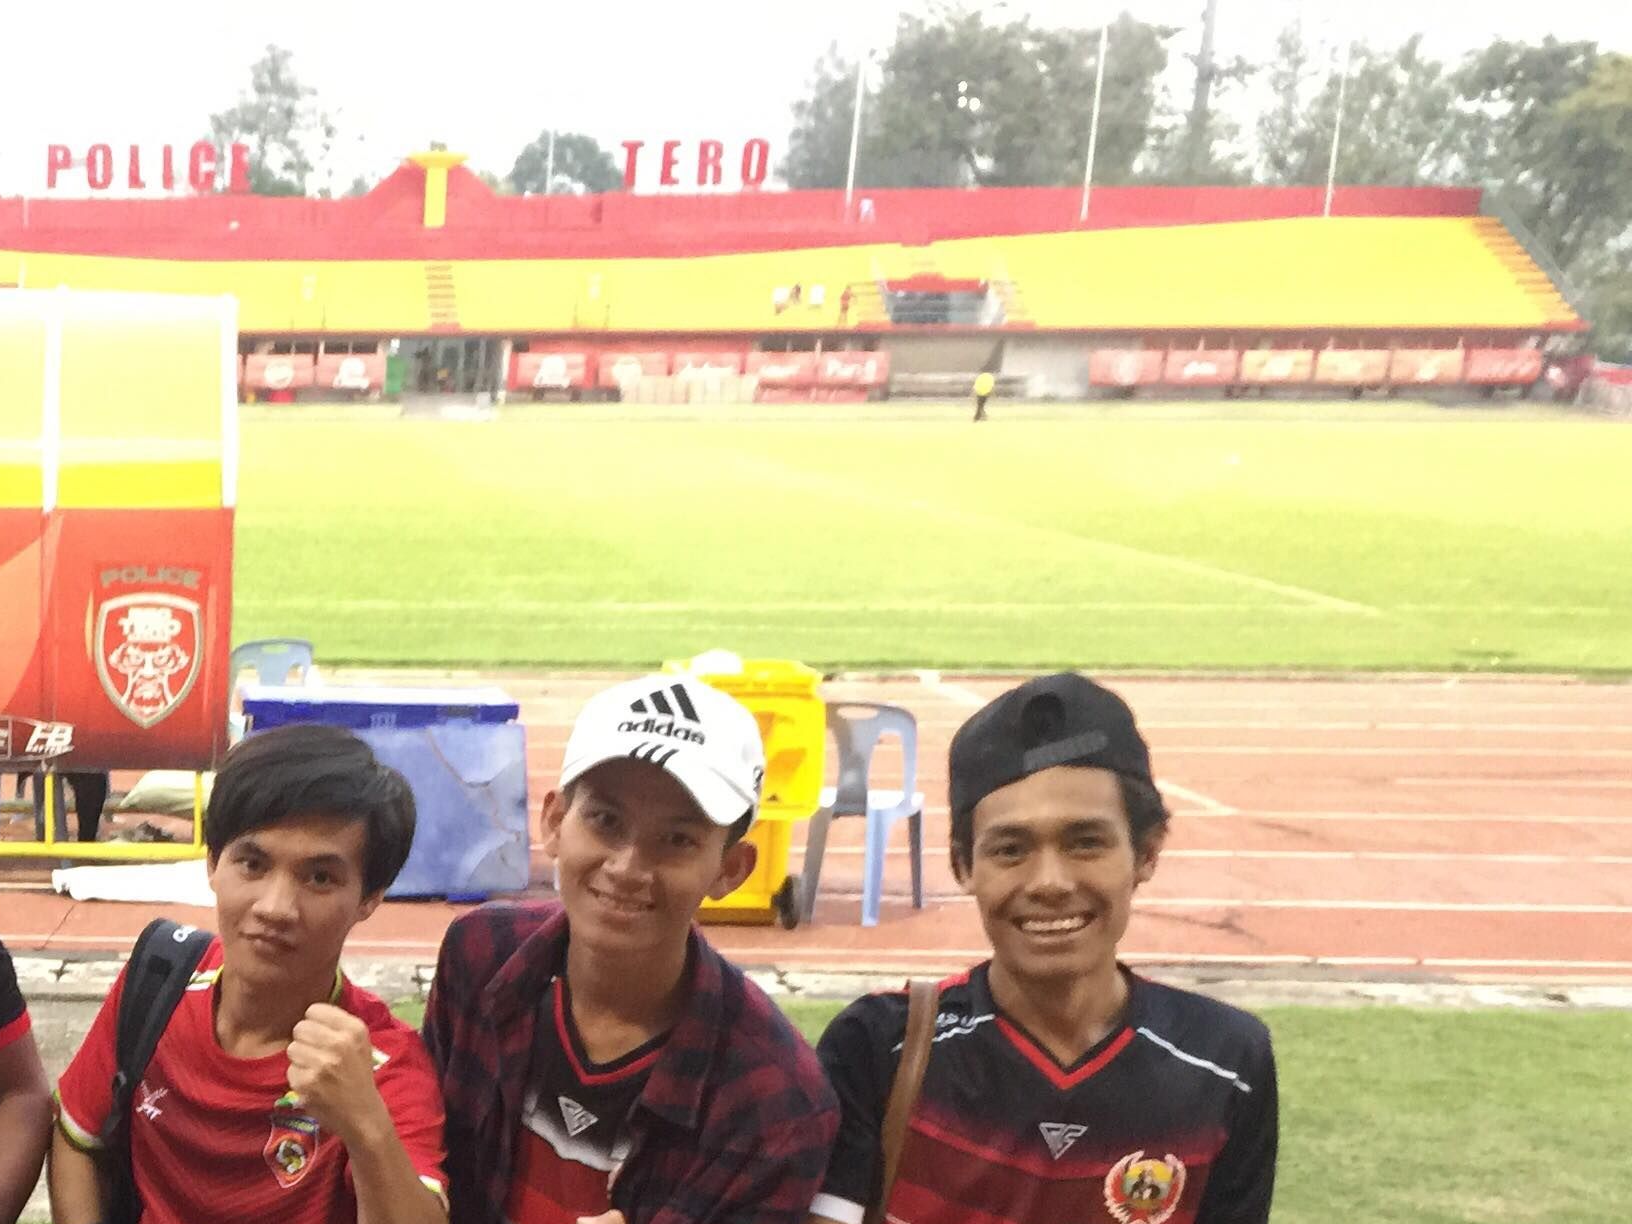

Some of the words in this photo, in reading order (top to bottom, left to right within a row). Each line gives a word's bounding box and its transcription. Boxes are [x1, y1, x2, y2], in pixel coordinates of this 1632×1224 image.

[47, 139, 251, 192] POLICE
[621, 138, 771, 188] TERO
[100, 566, 202, 589] POLICE
[618, 719, 706, 745] adidas
